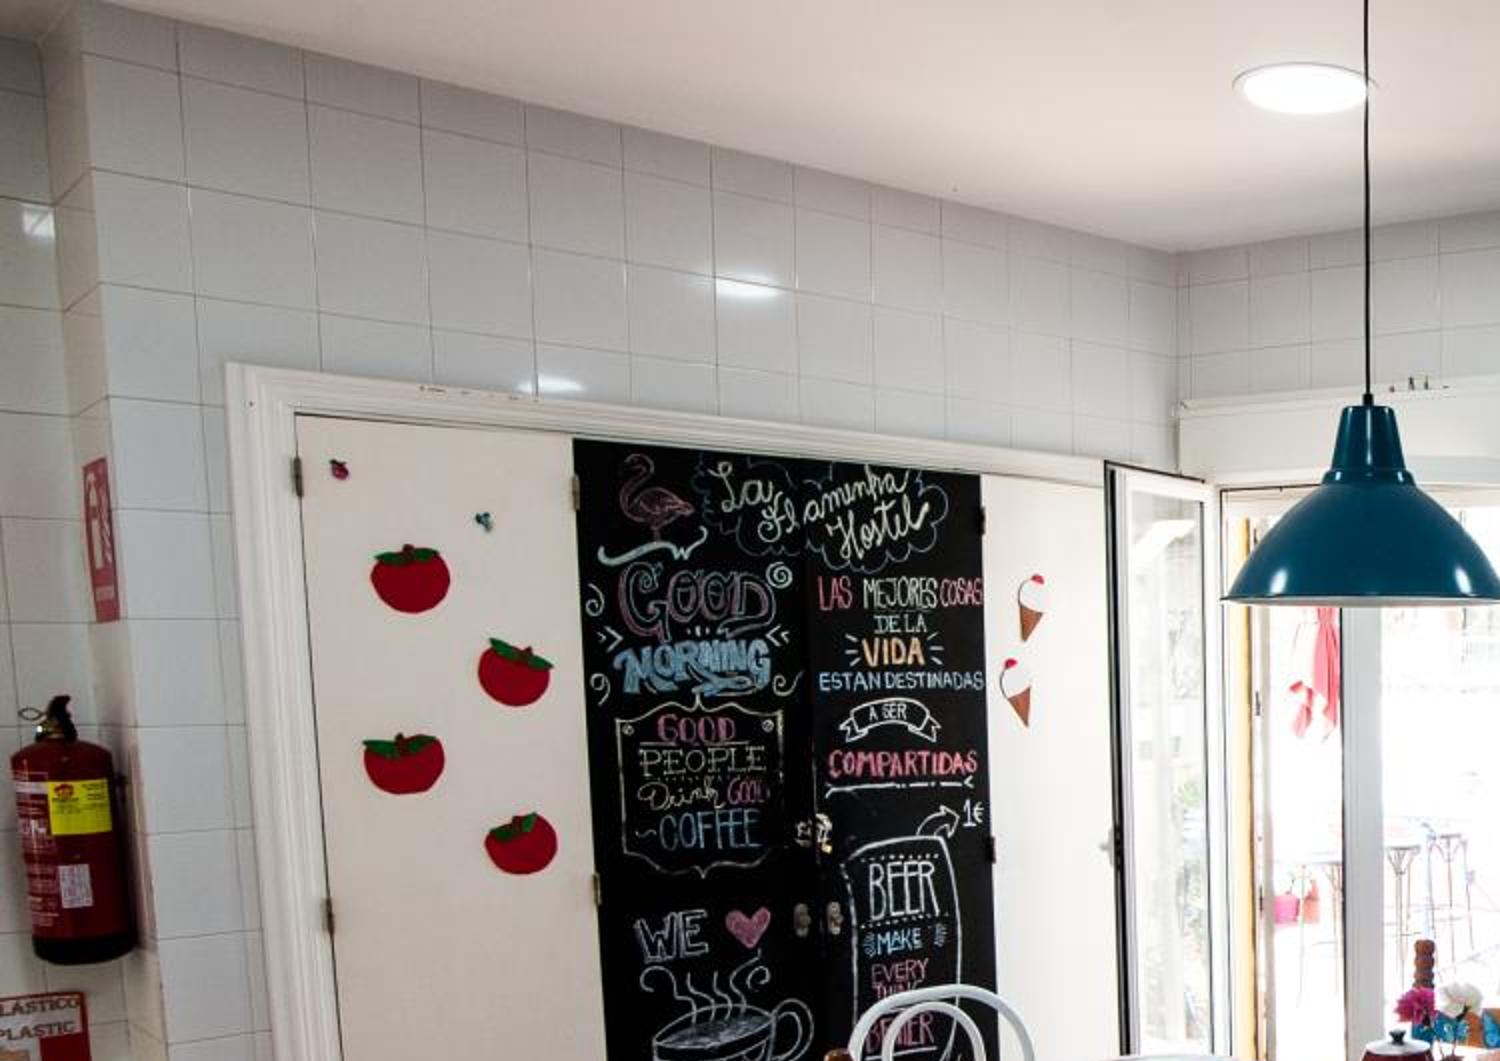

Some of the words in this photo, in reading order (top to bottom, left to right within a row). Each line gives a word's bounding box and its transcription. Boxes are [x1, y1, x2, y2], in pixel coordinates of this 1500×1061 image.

[707, 461, 774, 513] La
[826, 494, 930, 560] Hostel
[817, 575, 853, 611] LAS
[862, 576, 938, 609] MEJORES
[939, 578, 984, 607] COSAS
[873, 614, 901, 634] DE
[904, 613, 929, 633] LA
[861, 636, 926, 667] VIDA
[819, 671, 882, 692] ESTAN
[884, 671, 985, 690] DESTINADAS
[868, 706, 879, 721] A
[881, 703, 908, 719] SER
[657, 713, 737, 743] GOOD
[639, 745, 767, 777] PEOPLE
[828, 750, 978, 778] COMPARTIDAS
[962, 798, 985, 827] 1€
[658, 807, 764, 851] COFFEE
[869, 860, 940, 922] BEER
[633, 908, 709, 965] WE
[877, 926, 923, 955] MAKE
[871, 957, 929, 989] EVERY
